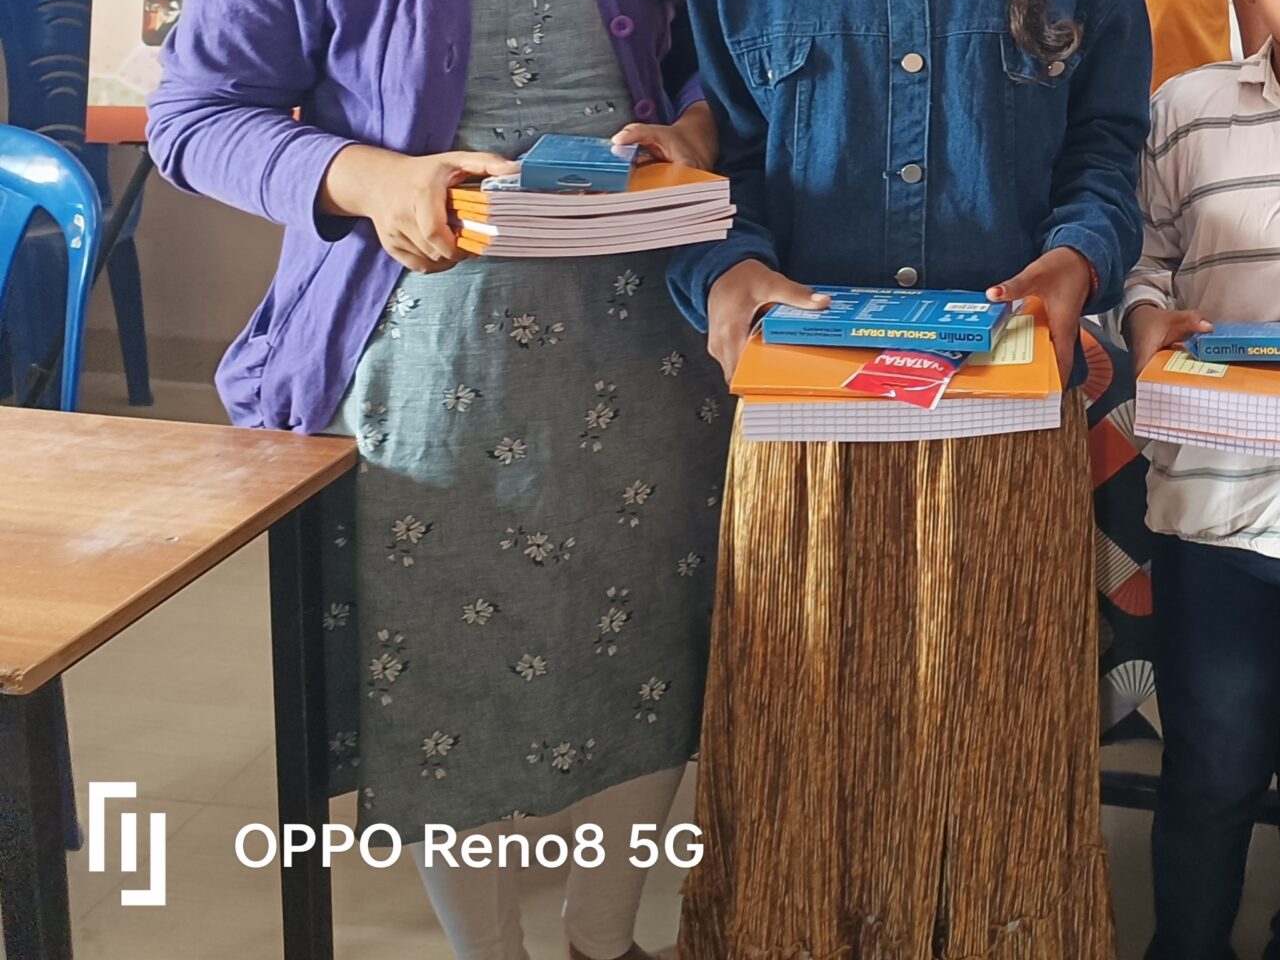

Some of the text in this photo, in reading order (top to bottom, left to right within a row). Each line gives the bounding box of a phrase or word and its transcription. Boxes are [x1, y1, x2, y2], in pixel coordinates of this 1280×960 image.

[850, 327, 984, 343] camlin SCHOLAR DRAFT
[1204, 342, 1246, 355] camlin
